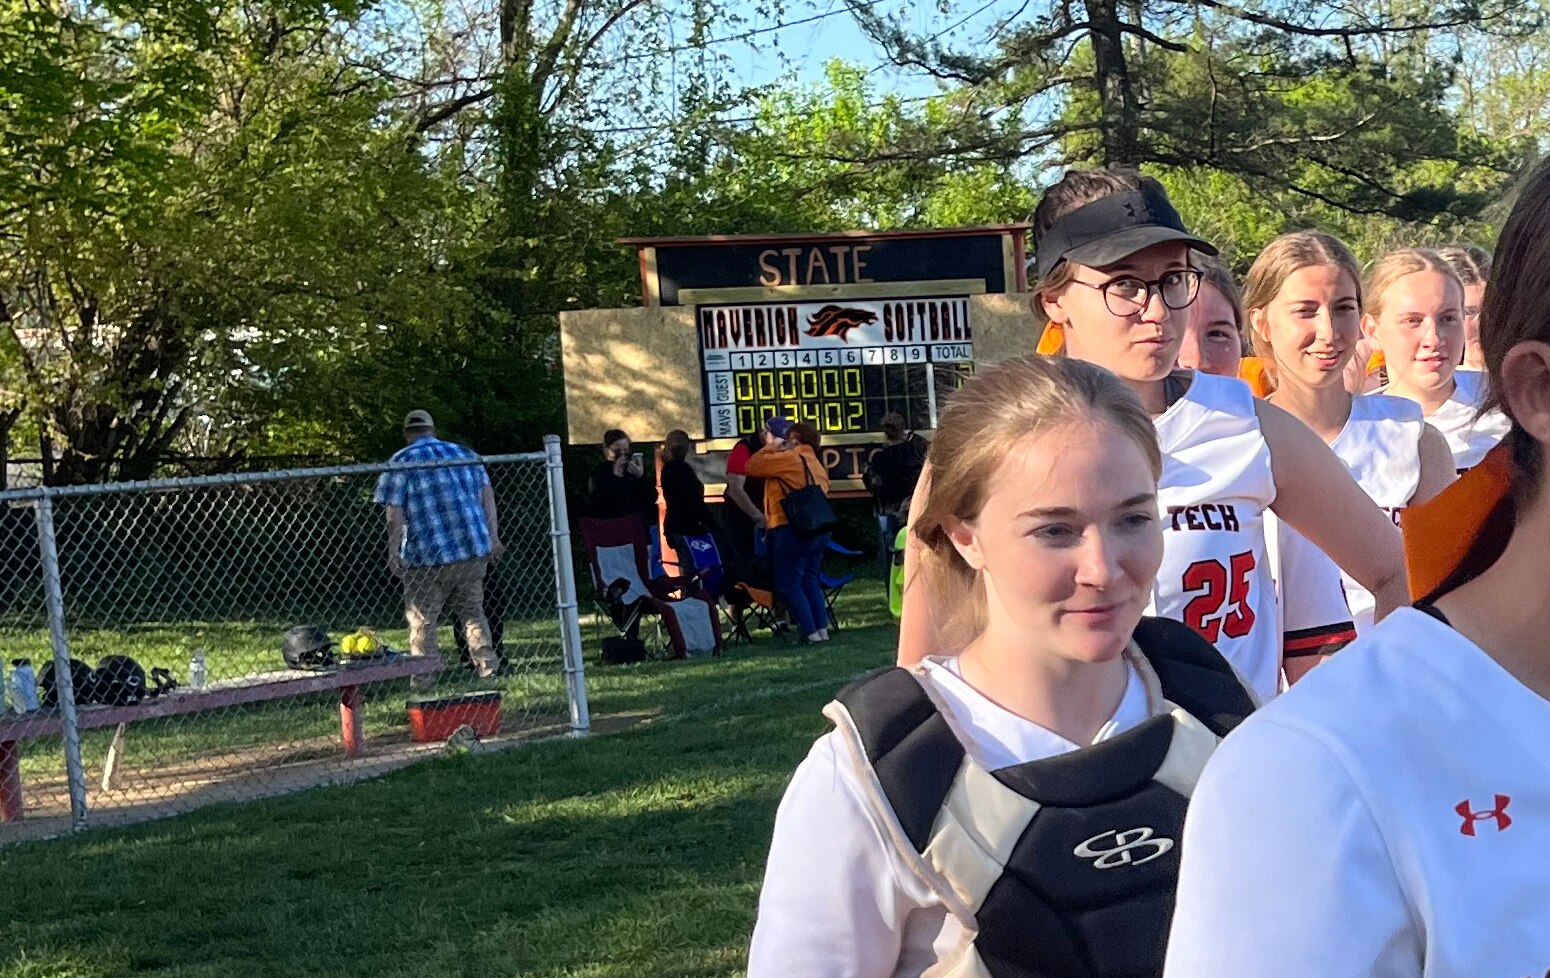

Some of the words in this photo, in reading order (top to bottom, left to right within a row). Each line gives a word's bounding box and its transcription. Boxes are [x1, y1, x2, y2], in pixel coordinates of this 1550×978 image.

[759, 246, 874, 286] STATE
[702, 307, 800, 349] MAVERICK
[883, 301, 972, 342] SOFTBALL
[738, 355, 746, 367] 1
[759, 354, 768, 366] 2
[781, 353, 790, 365] 3
[802, 352, 811, 364] 4
[824, 352, 833, 363] 5
[847, 350, 856, 362] 6
[868, 350, 876, 361] 7
[890, 349, 899, 361] 8
[911, 349, 920, 360] 9
[935, 346, 970, 359] TOTAL
[715, 374, 729, 401] GUEST
[718, 408, 732, 435] MAVS
[1166, 504, 1239, 532] TECH
[1182, 550, 1256, 644] 25
